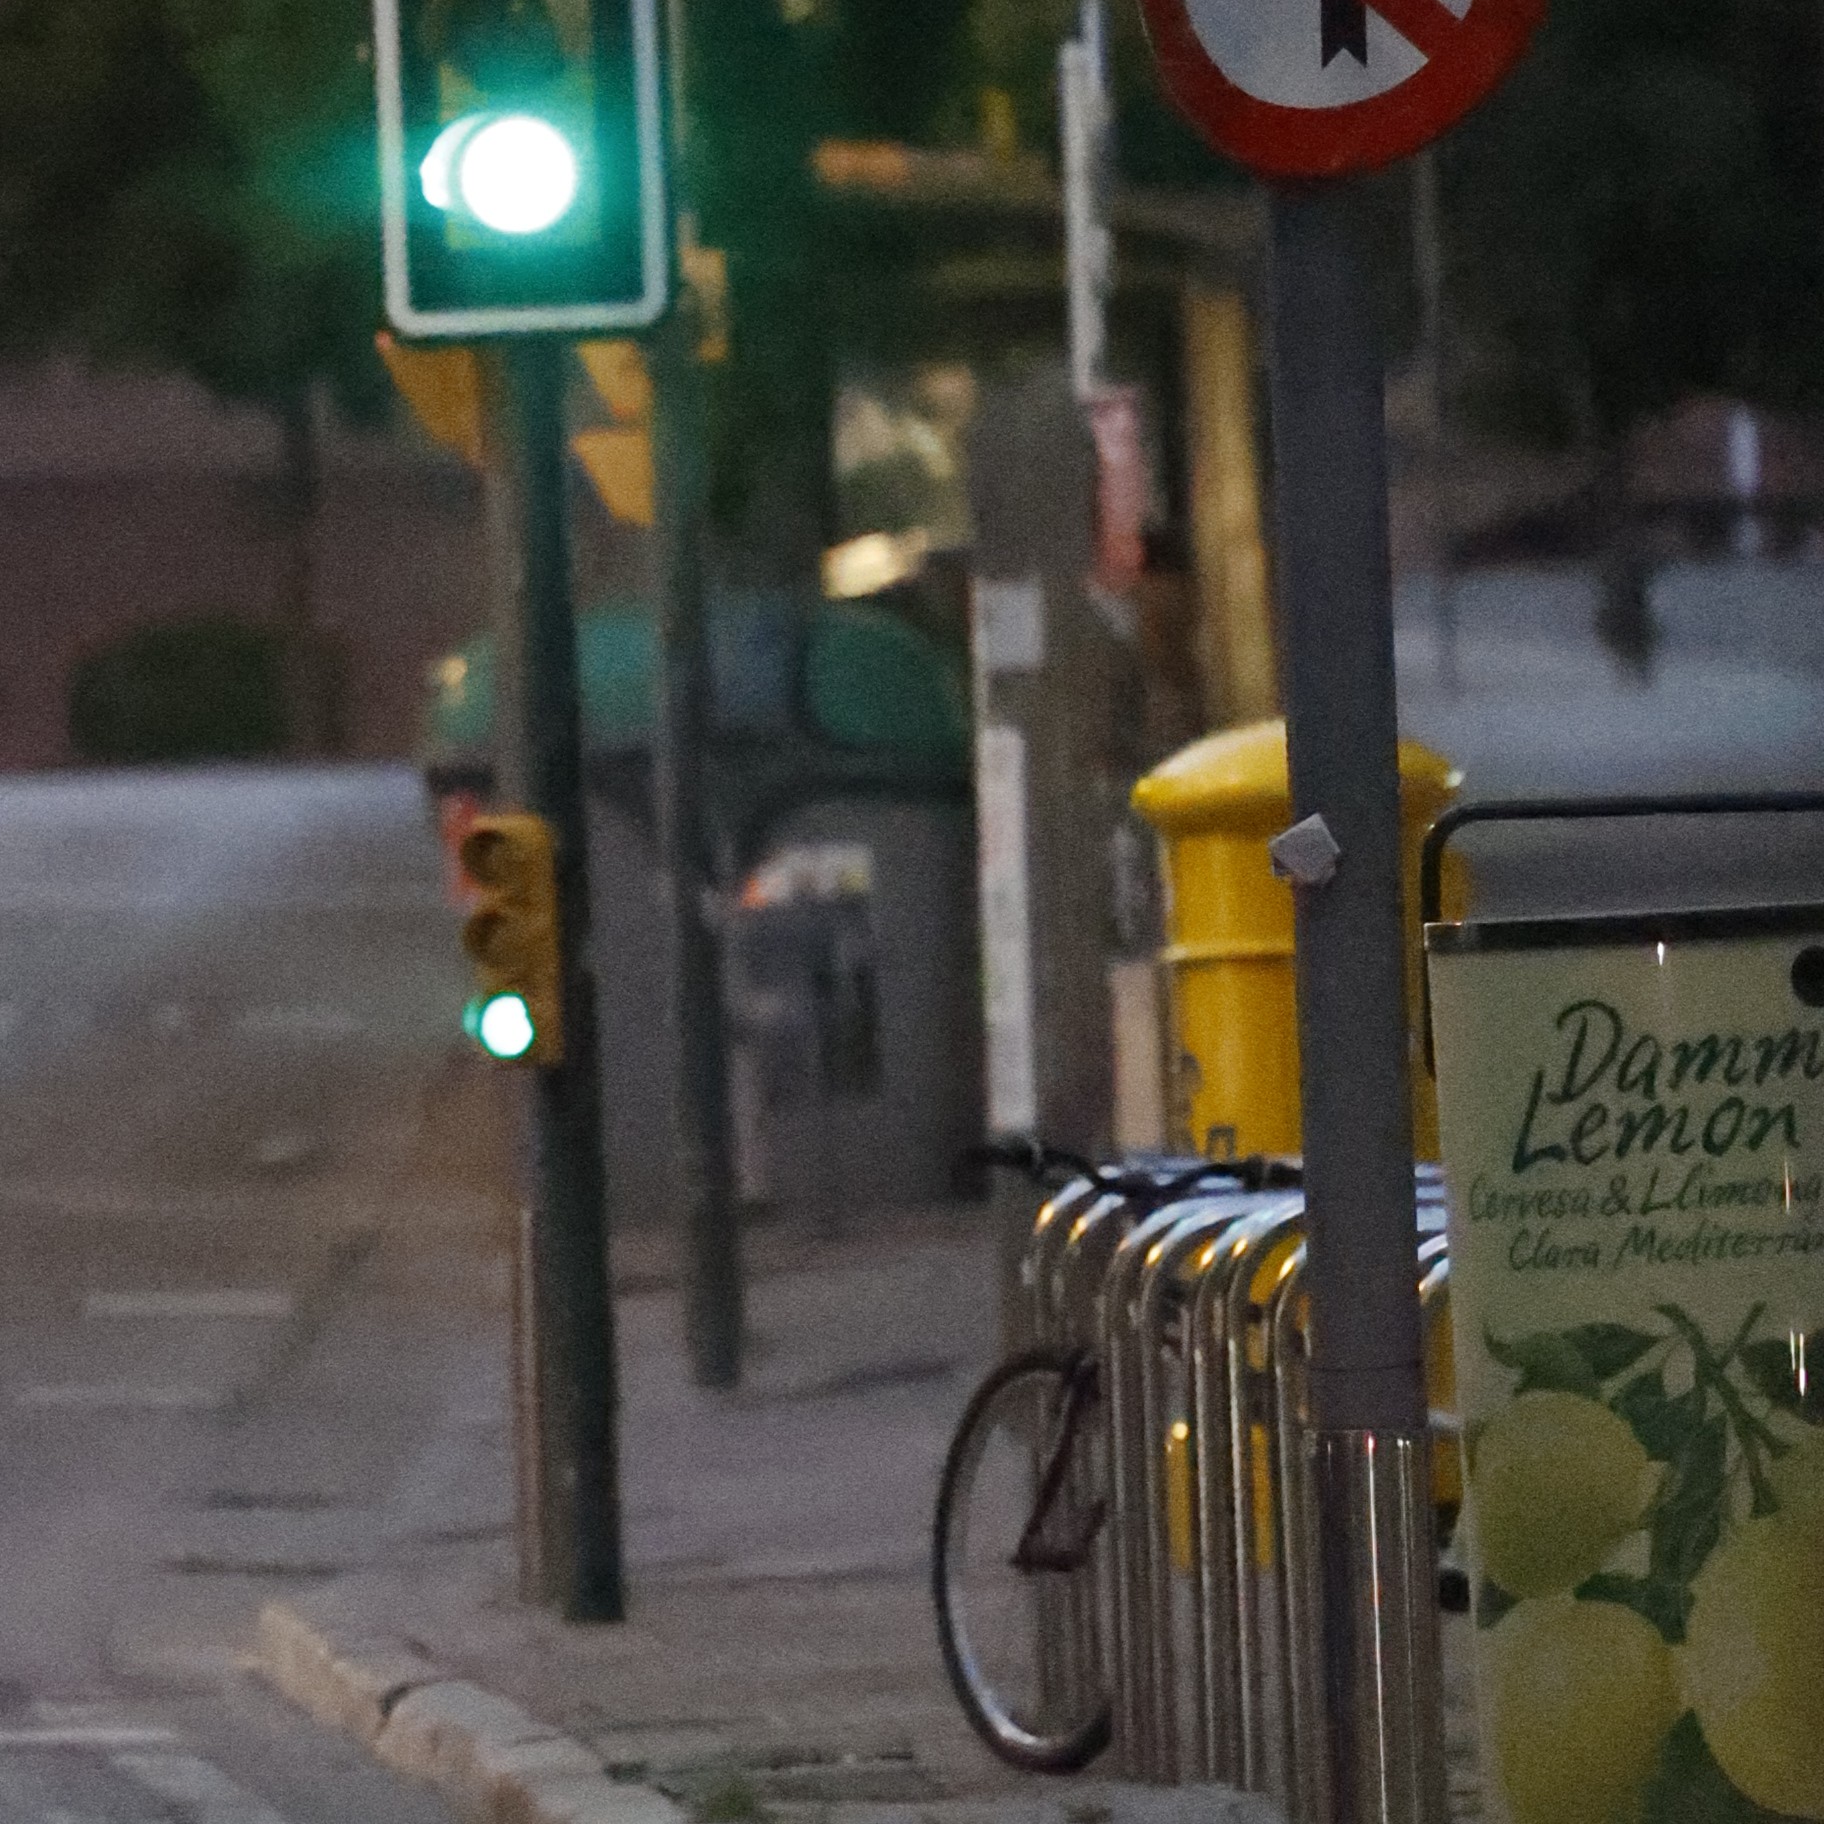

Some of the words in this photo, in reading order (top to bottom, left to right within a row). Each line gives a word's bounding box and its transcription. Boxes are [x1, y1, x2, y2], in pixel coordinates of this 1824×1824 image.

[1546, 999, 1824, 1105] Damm
[1512, 1069, 1801, 1174] Lemon
[1469, 1176, 1590, 1221] Cervesa
[1600, 1174, 1631, 1217] &
[1509, 1228, 1600, 1272] Clara
